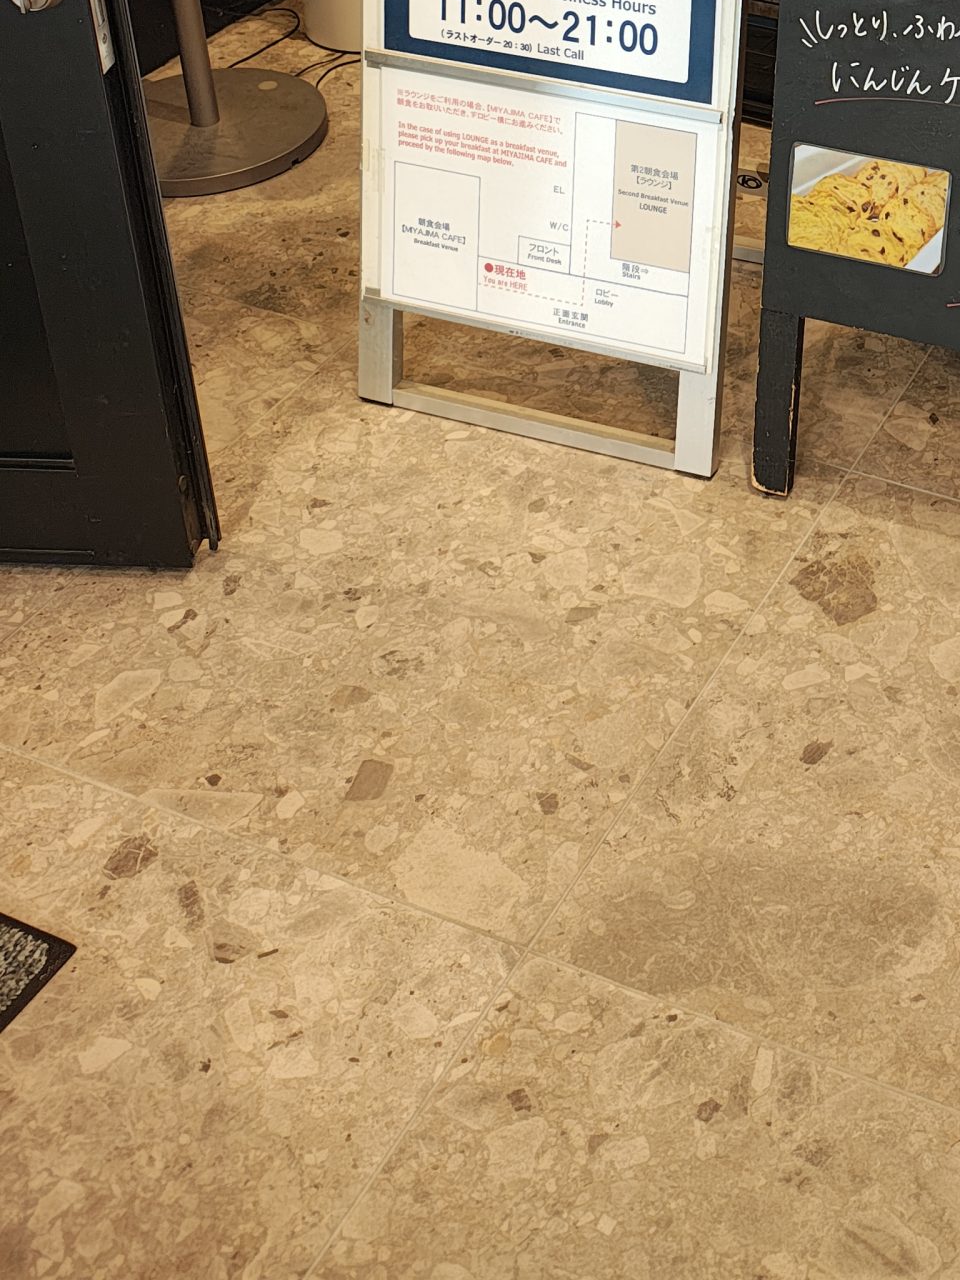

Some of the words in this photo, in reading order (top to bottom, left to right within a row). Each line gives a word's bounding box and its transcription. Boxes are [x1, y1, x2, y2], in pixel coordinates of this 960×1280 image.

[537, 43, 561, 57] Last
[563, 47, 585, 61] Call
[398, 120, 406, 129] In
[407, 122, 418, 131] the
[419, 125, 433, 135] case
[443, 130, 461, 140] using
[462, 132, 489, 144] LOUNGE
[505, 140, 536, 153] breakfast
[537, 148, 560, 159] venue,
[398, 130, 418, 140] please
[420, 134, 433, 143] pick
[434, 137, 443, 145] up
[444, 139, 460, 147] your
[460, 141, 491, 153] breakfast
[492, 147, 499, 155] at
[500, 149, 534, 161] MIYAJIMA
[535, 155, 553, 166] CAFE
[554, 160, 567, 168] and
[398, 139, 424, 150] proceed
[425, 143, 433, 152] by
[434, 145, 445, 153] the
[446, 147, 476, 160] following
[477, 154, 492, 163] map
[492, 156, 514, 167] below.
[618, 188, 640, 198] Second
[640, 192, 669, 204] Breakfast
[670, 197, 689, 207] Venue
[639, 202, 668, 214] LOUNGE
[418, 217, 450, 232] 朝食会場
[549, 221, 569, 232] W/C
[413, 237, 440, 250] Breakfast
[441, 241, 459, 252] Venue
[528, 243, 559, 256] フロント
[527, 253, 544, 263] Front
[545, 256, 562, 266] Desk
[622, 271, 641, 280] Stairs
[483, 275, 496, 286] You
[497, 278, 508, 288] are
[509, 281, 528, 292] HERE
[595, 288, 620, 298] ロビー
[594, 298, 614, 308] Lobby
[558, 317, 586, 329] Entrance
